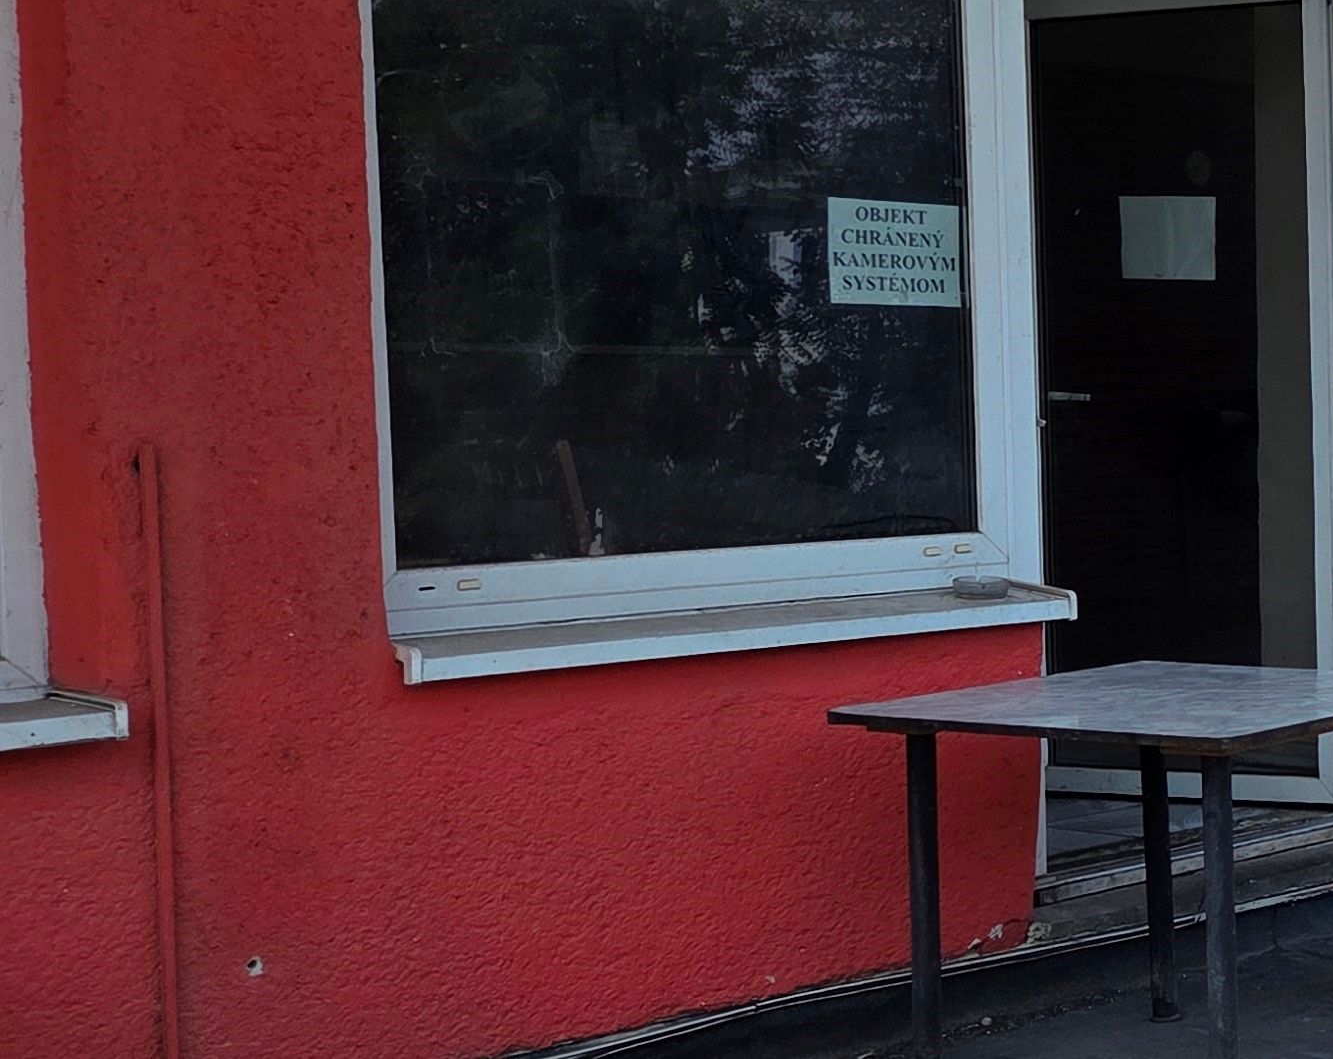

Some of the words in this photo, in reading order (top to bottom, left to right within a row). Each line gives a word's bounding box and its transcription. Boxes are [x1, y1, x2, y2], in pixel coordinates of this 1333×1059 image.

[855, 206, 927, 225] OBJEKT
[841, 226, 945, 249] CHRÁNENÝ
[833, 251, 956, 272] KAMEROVÝM
[842, 273, 945, 293] SYSTÉMOM
